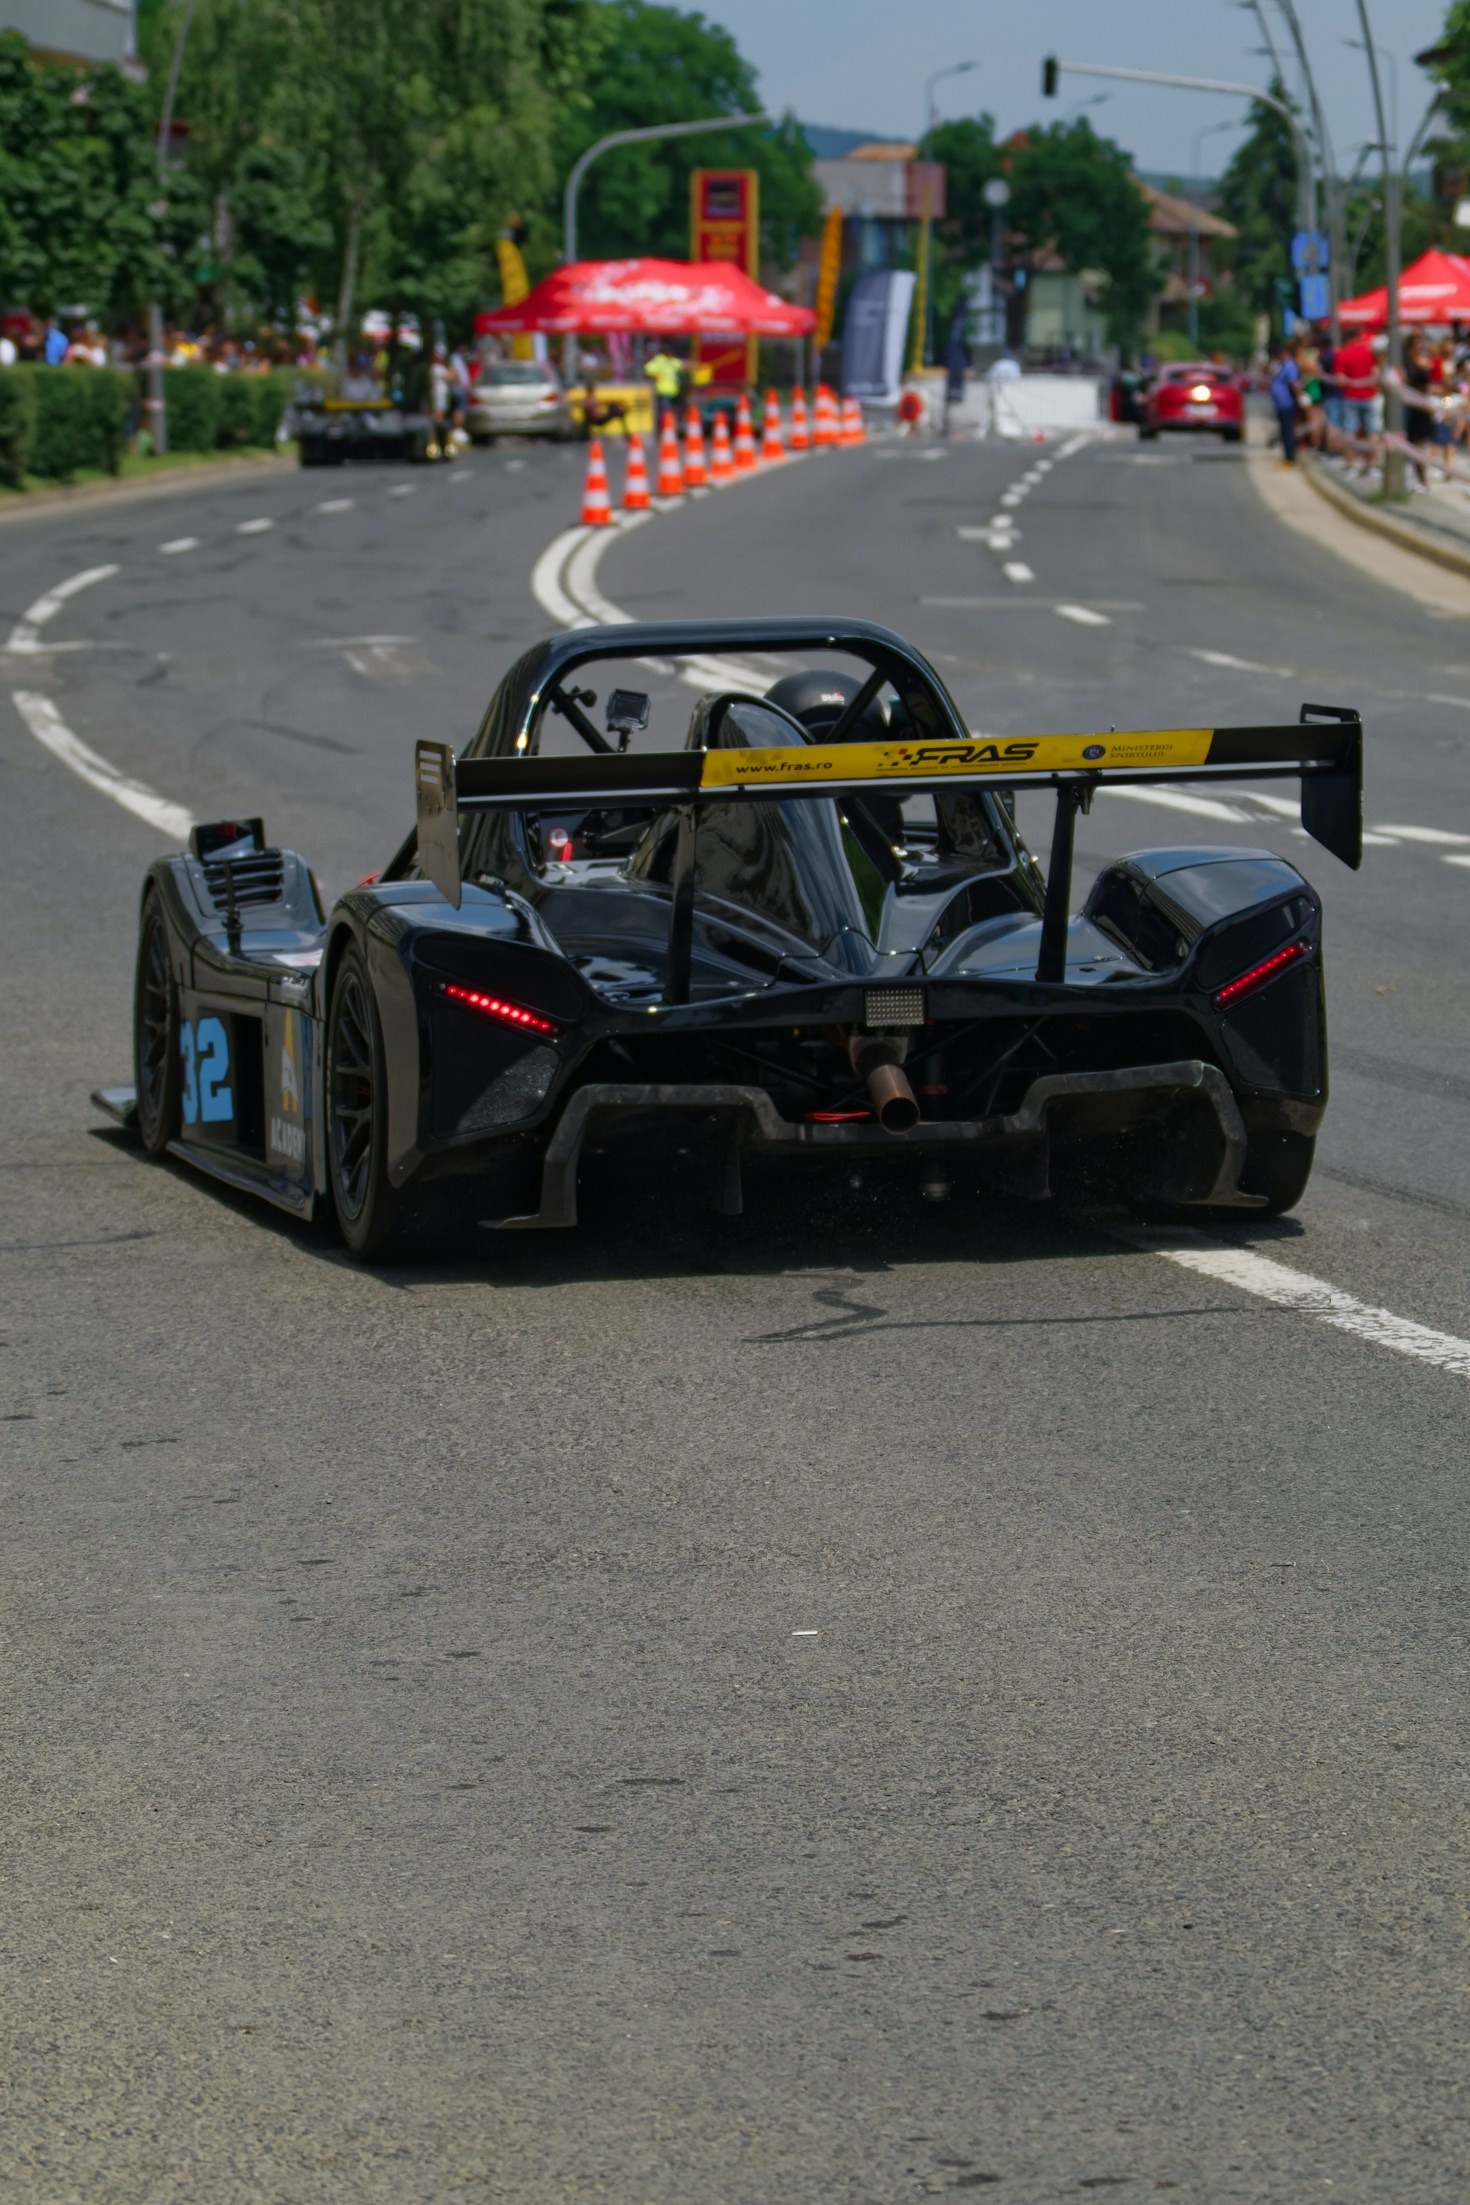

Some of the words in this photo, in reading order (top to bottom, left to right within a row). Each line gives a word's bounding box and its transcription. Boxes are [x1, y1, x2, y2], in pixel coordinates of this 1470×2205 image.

[909, 742, 1040, 765] FRAS
[735, 761, 833, 774] www.fras.ro
[180, 1016, 234, 1125] 32
